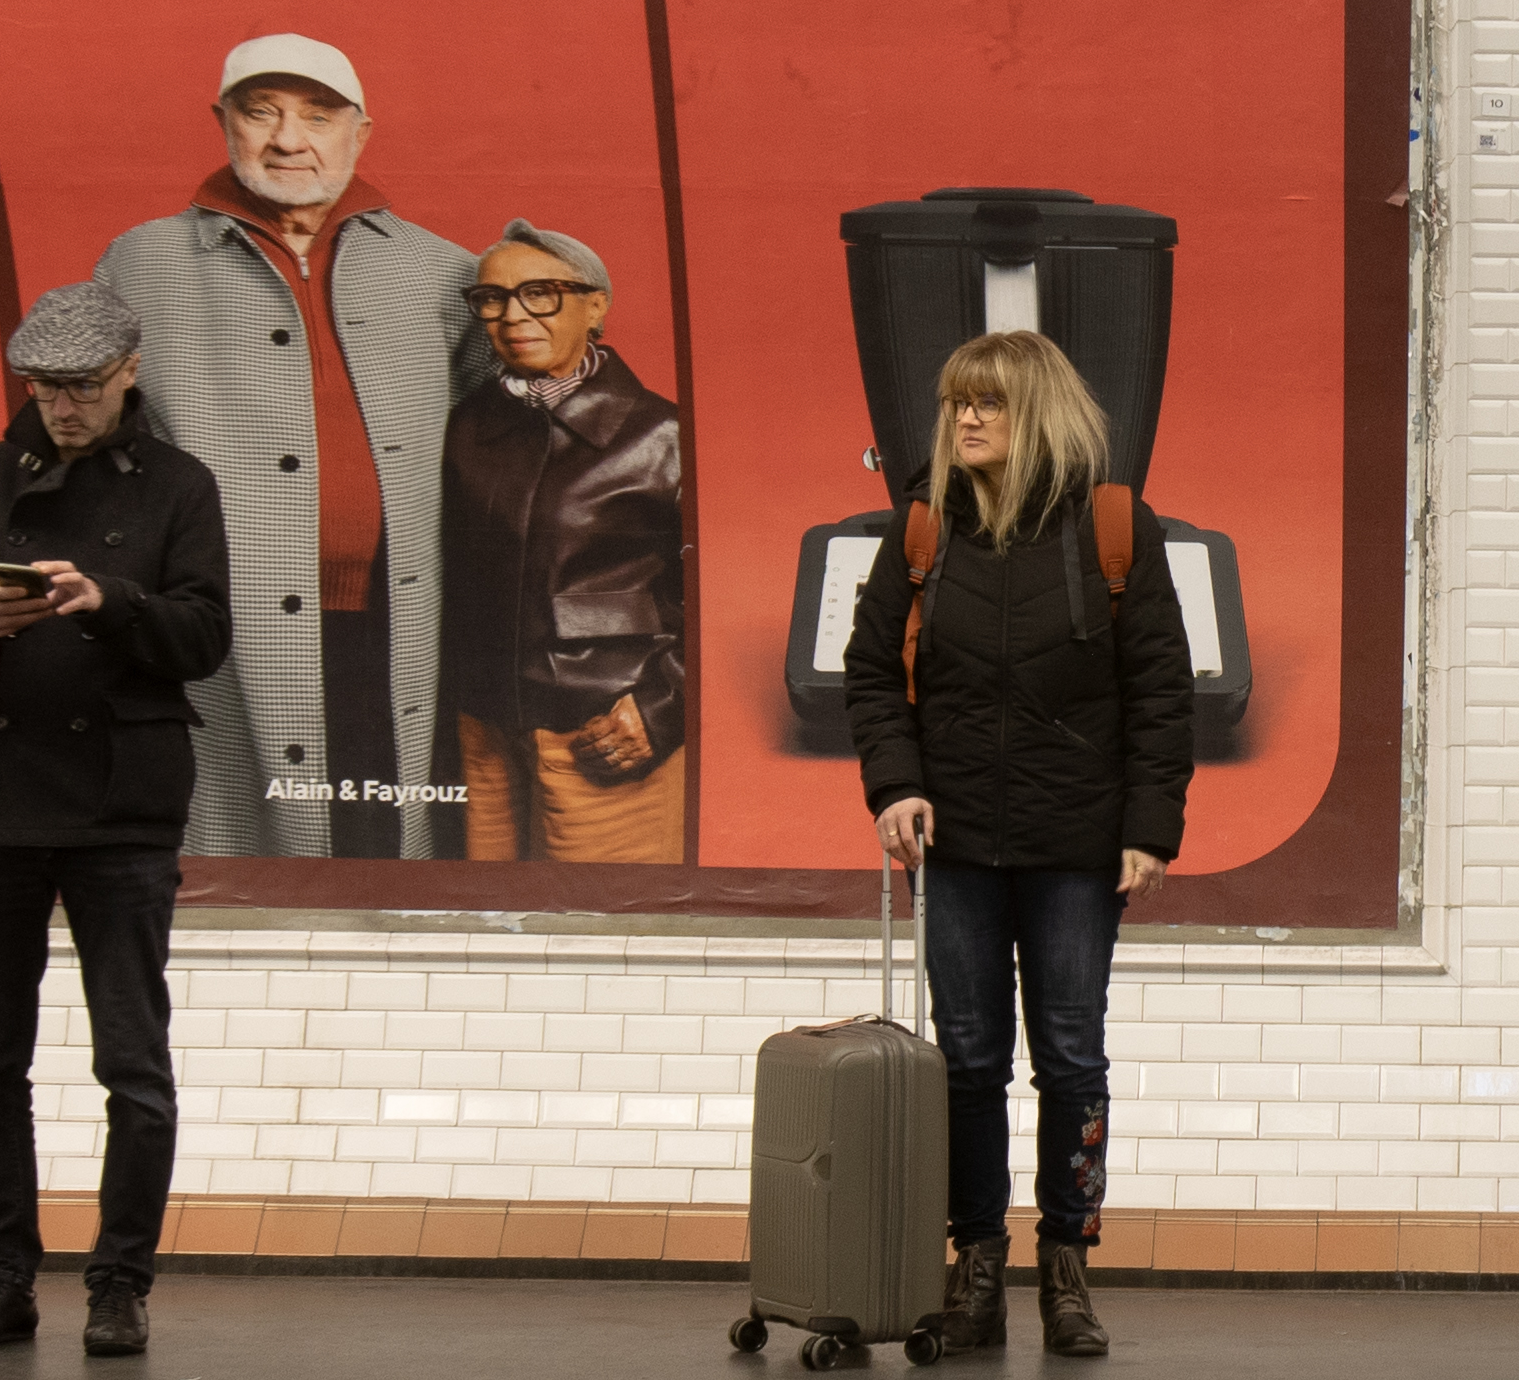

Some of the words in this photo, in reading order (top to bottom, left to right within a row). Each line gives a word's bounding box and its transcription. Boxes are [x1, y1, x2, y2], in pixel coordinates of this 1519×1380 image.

[265, 778, 333, 800] Alain
[339, 779, 358, 801] &
[363, 779, 468, 807] Fayrouz
